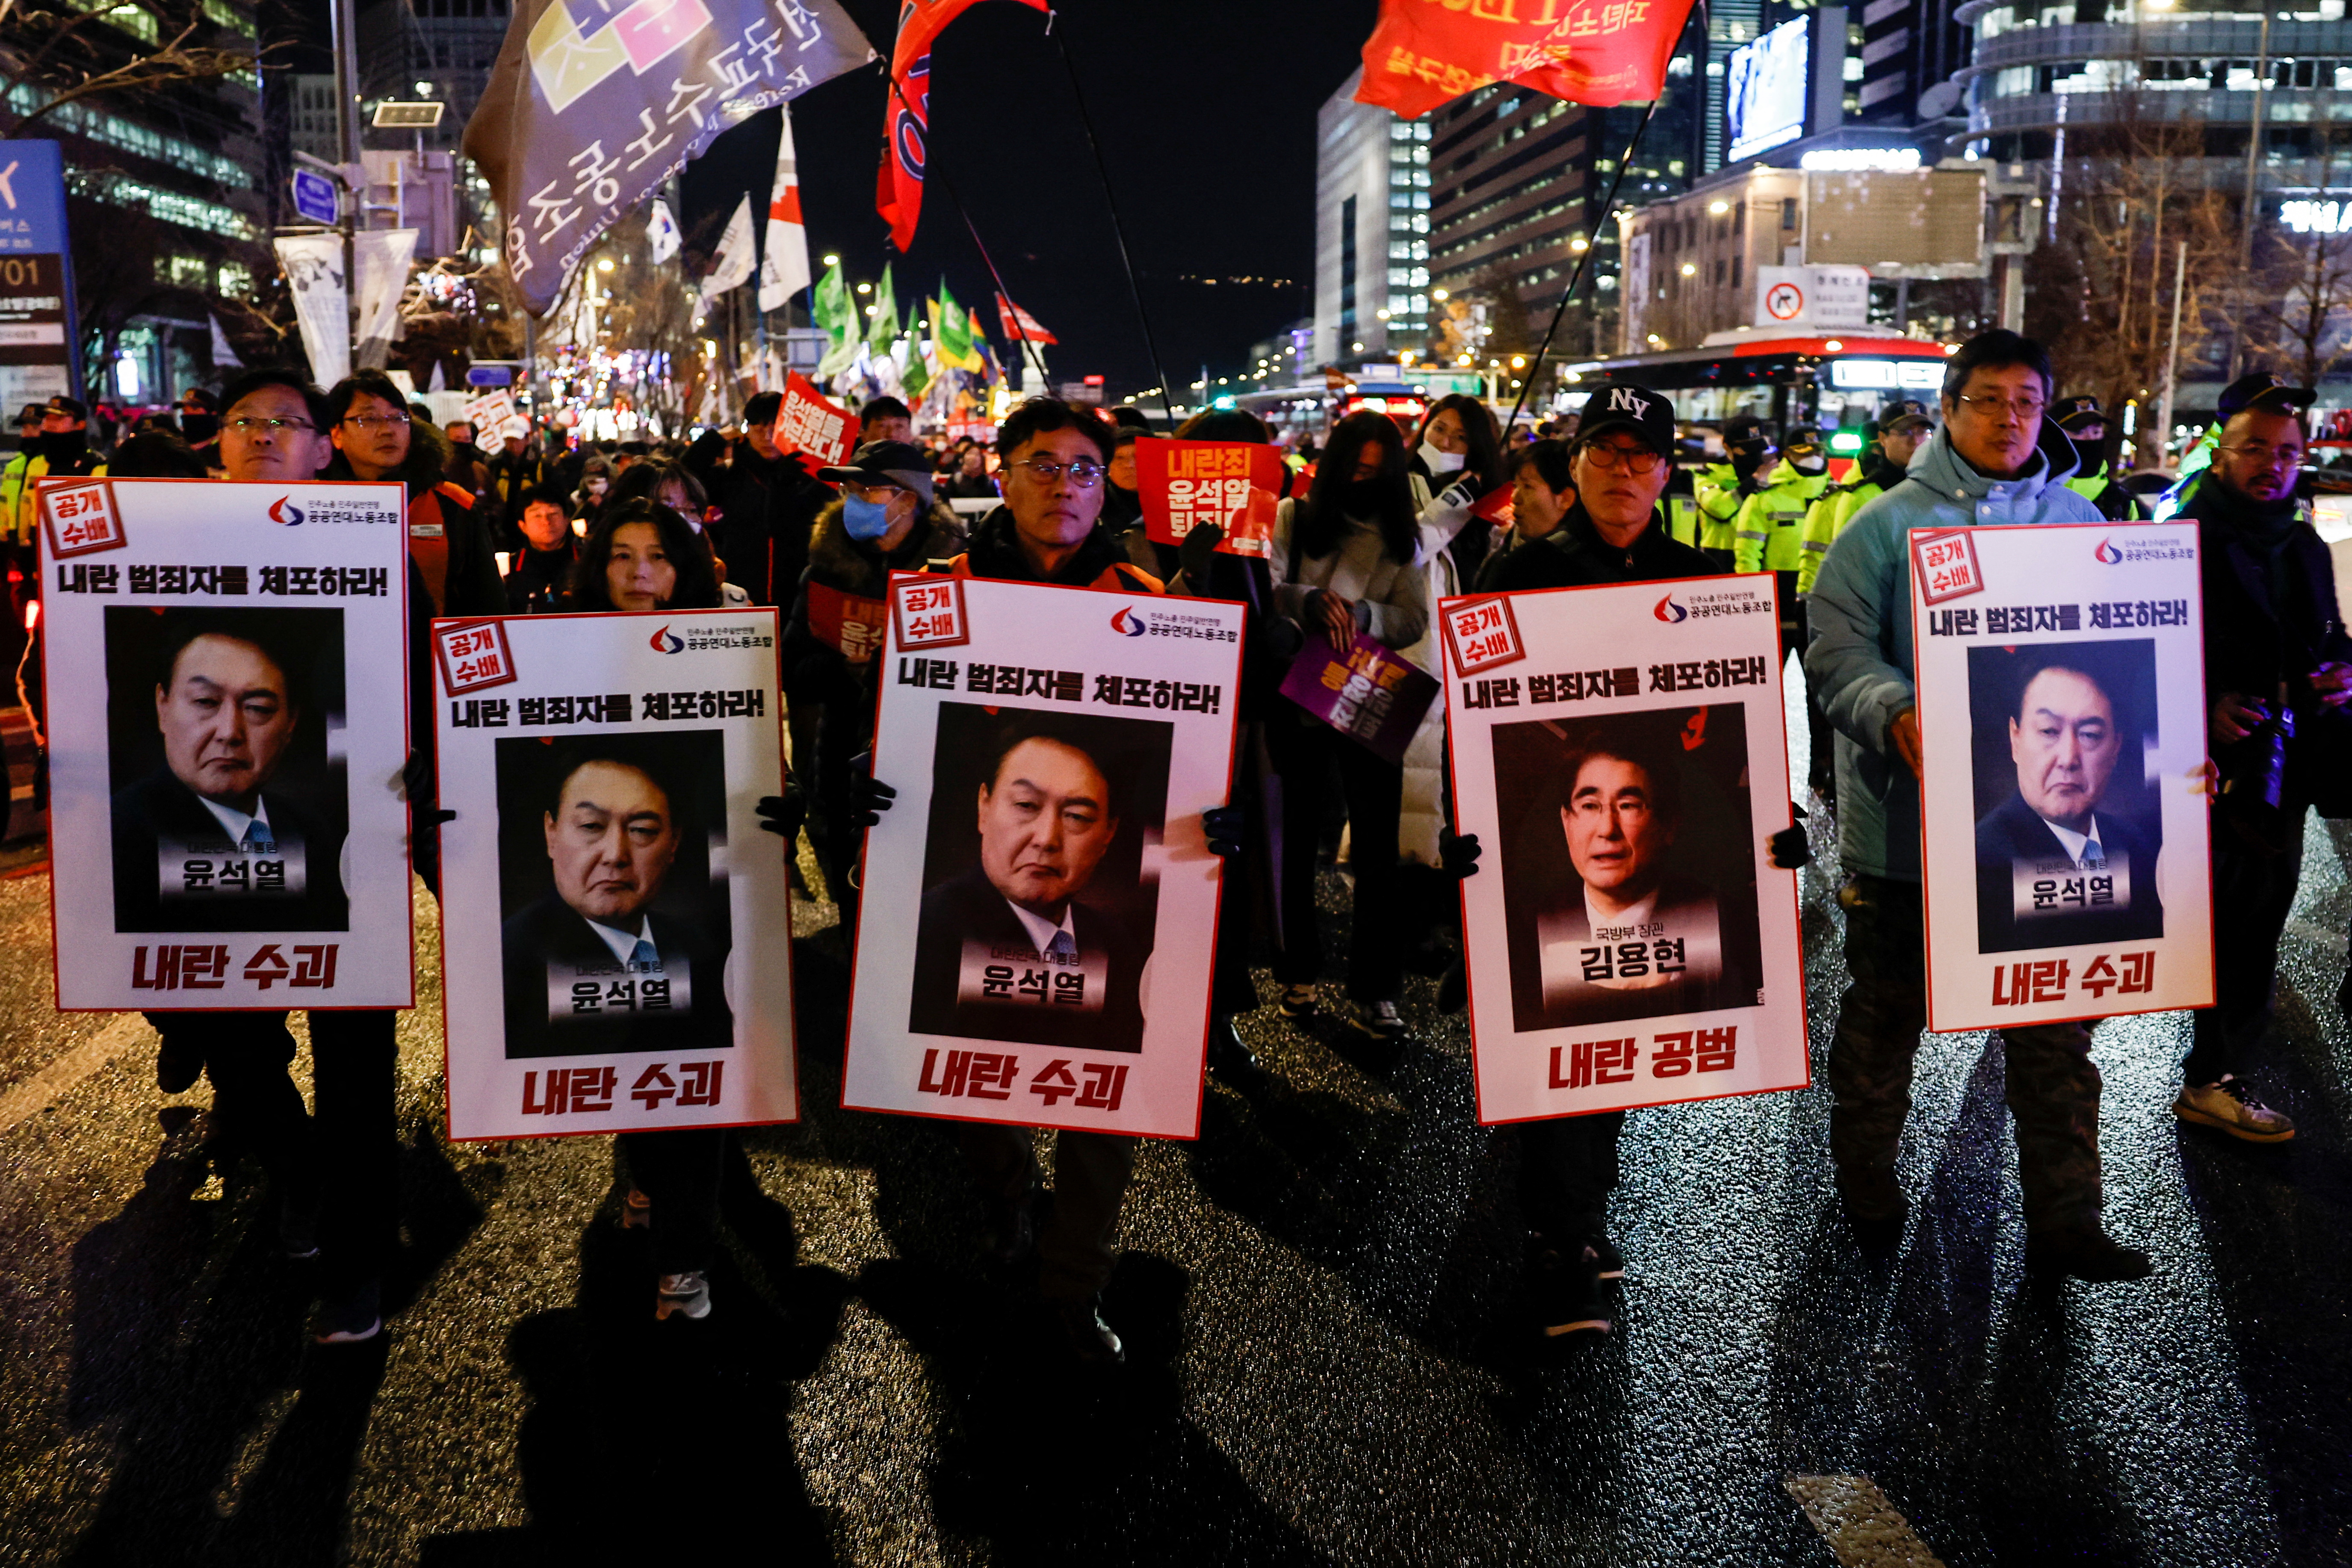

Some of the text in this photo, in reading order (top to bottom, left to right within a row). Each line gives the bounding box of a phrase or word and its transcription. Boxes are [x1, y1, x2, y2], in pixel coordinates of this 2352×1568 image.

[0, 259, 39, 285] 01
[784, 390, 845, 440] 윤석열을
[1607, 387, 1651, 421] NY
[778, 411, 845, 465] 거부한다!
[1167, 447, 1252, 478] 내란죄
[55, 489, 102, 519] 공개
[1167, 478, 1251, 510] 윤석열
[62, 516, 110, 546] 수배
[309, 511, 398, 523] 공공연대노동조합
[1925, 539, 1965, 568] 공개
[58, 564, 388, 597] 내란 범죄자를 체포하라!
[1932, 564, 1971, 593] 수배
[905, 585, 950, 612] 공개
[1690, 600, 1772, 618] 공공연대노동조합
[908, 613, 954, 640] 수배
[1149, 623, 1238, 642] 공공연대노동조합
[1456, 605, 1502, 637] 공개
[1929, 598, 2188, 636] 내란 범죄자를 체포하라!
[449, 628, 495, 657] 공개
[688, 636, 774, 650] 공공연대노동조합
[1465, 631, 1510, 663] 수배
[456, 653, 501, 682] 수배
[1462, 656, 1767, 710] 내란 범죄자를 체포하라!
[898, 657, 1221, 715] 내란 범죄자를 체포하라!
[452, 689, 764, 728] 내란 범죄자를 체포하라!
[183, 859, 286, 891] 윤석열
[2033, 874, 2114, 909] 윤석열
[1596, 922, 1664, 941] 국방부 장관
[132, 944, 340, 991] 내란 수괴
[1043, 951, 1080, 966] 대통령
[1580, 937, 1687, 981] 김용현
[983, 965, 1085, 1004] 윤석열
[1992, 951, 2156, 1007] 내란 수괴
[571, 978, 672, 1013] 윤석열
[1548, 1025, 1738, 1089] 내란 공범
[521, 1060, 724, 1116] 내란 수괴
[918, 1048, 1129, 1112] 내란 수괴
